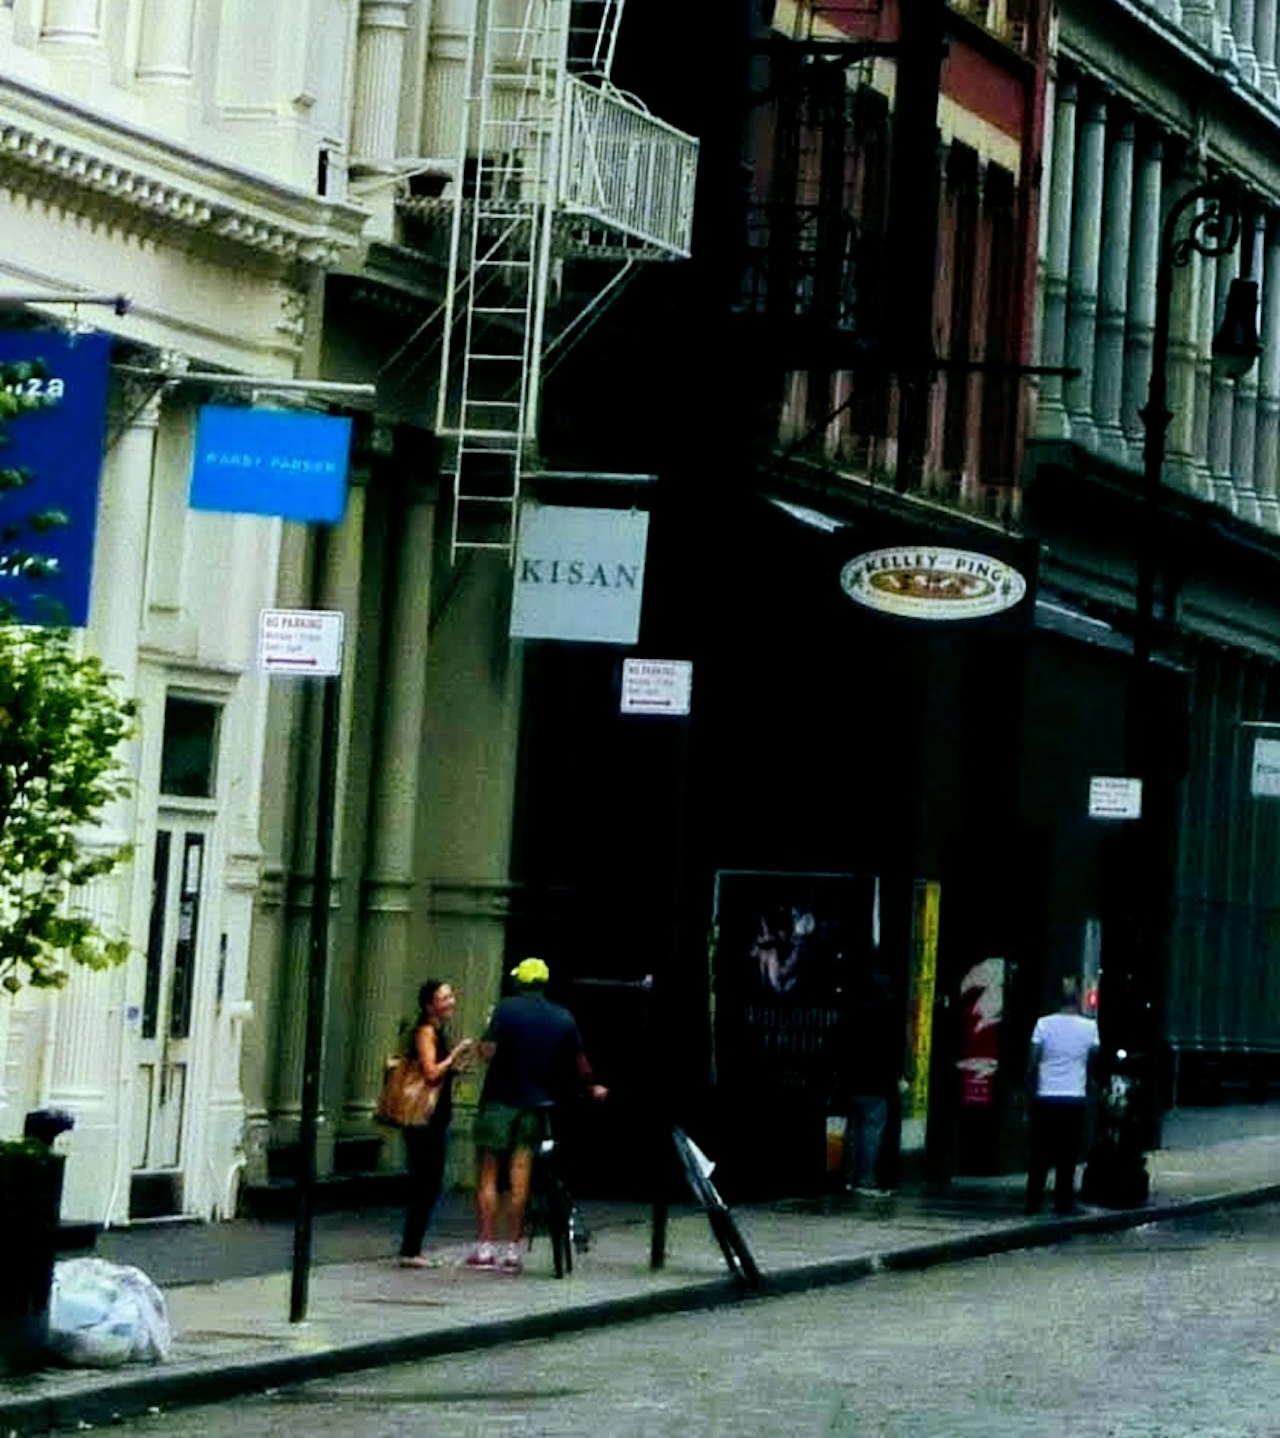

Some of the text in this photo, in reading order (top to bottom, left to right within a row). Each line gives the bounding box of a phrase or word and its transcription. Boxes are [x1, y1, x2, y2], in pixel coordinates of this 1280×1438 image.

[520, 556, 639, 590] KISAN
[865, 554, 1002, 581] KELLEY PING
